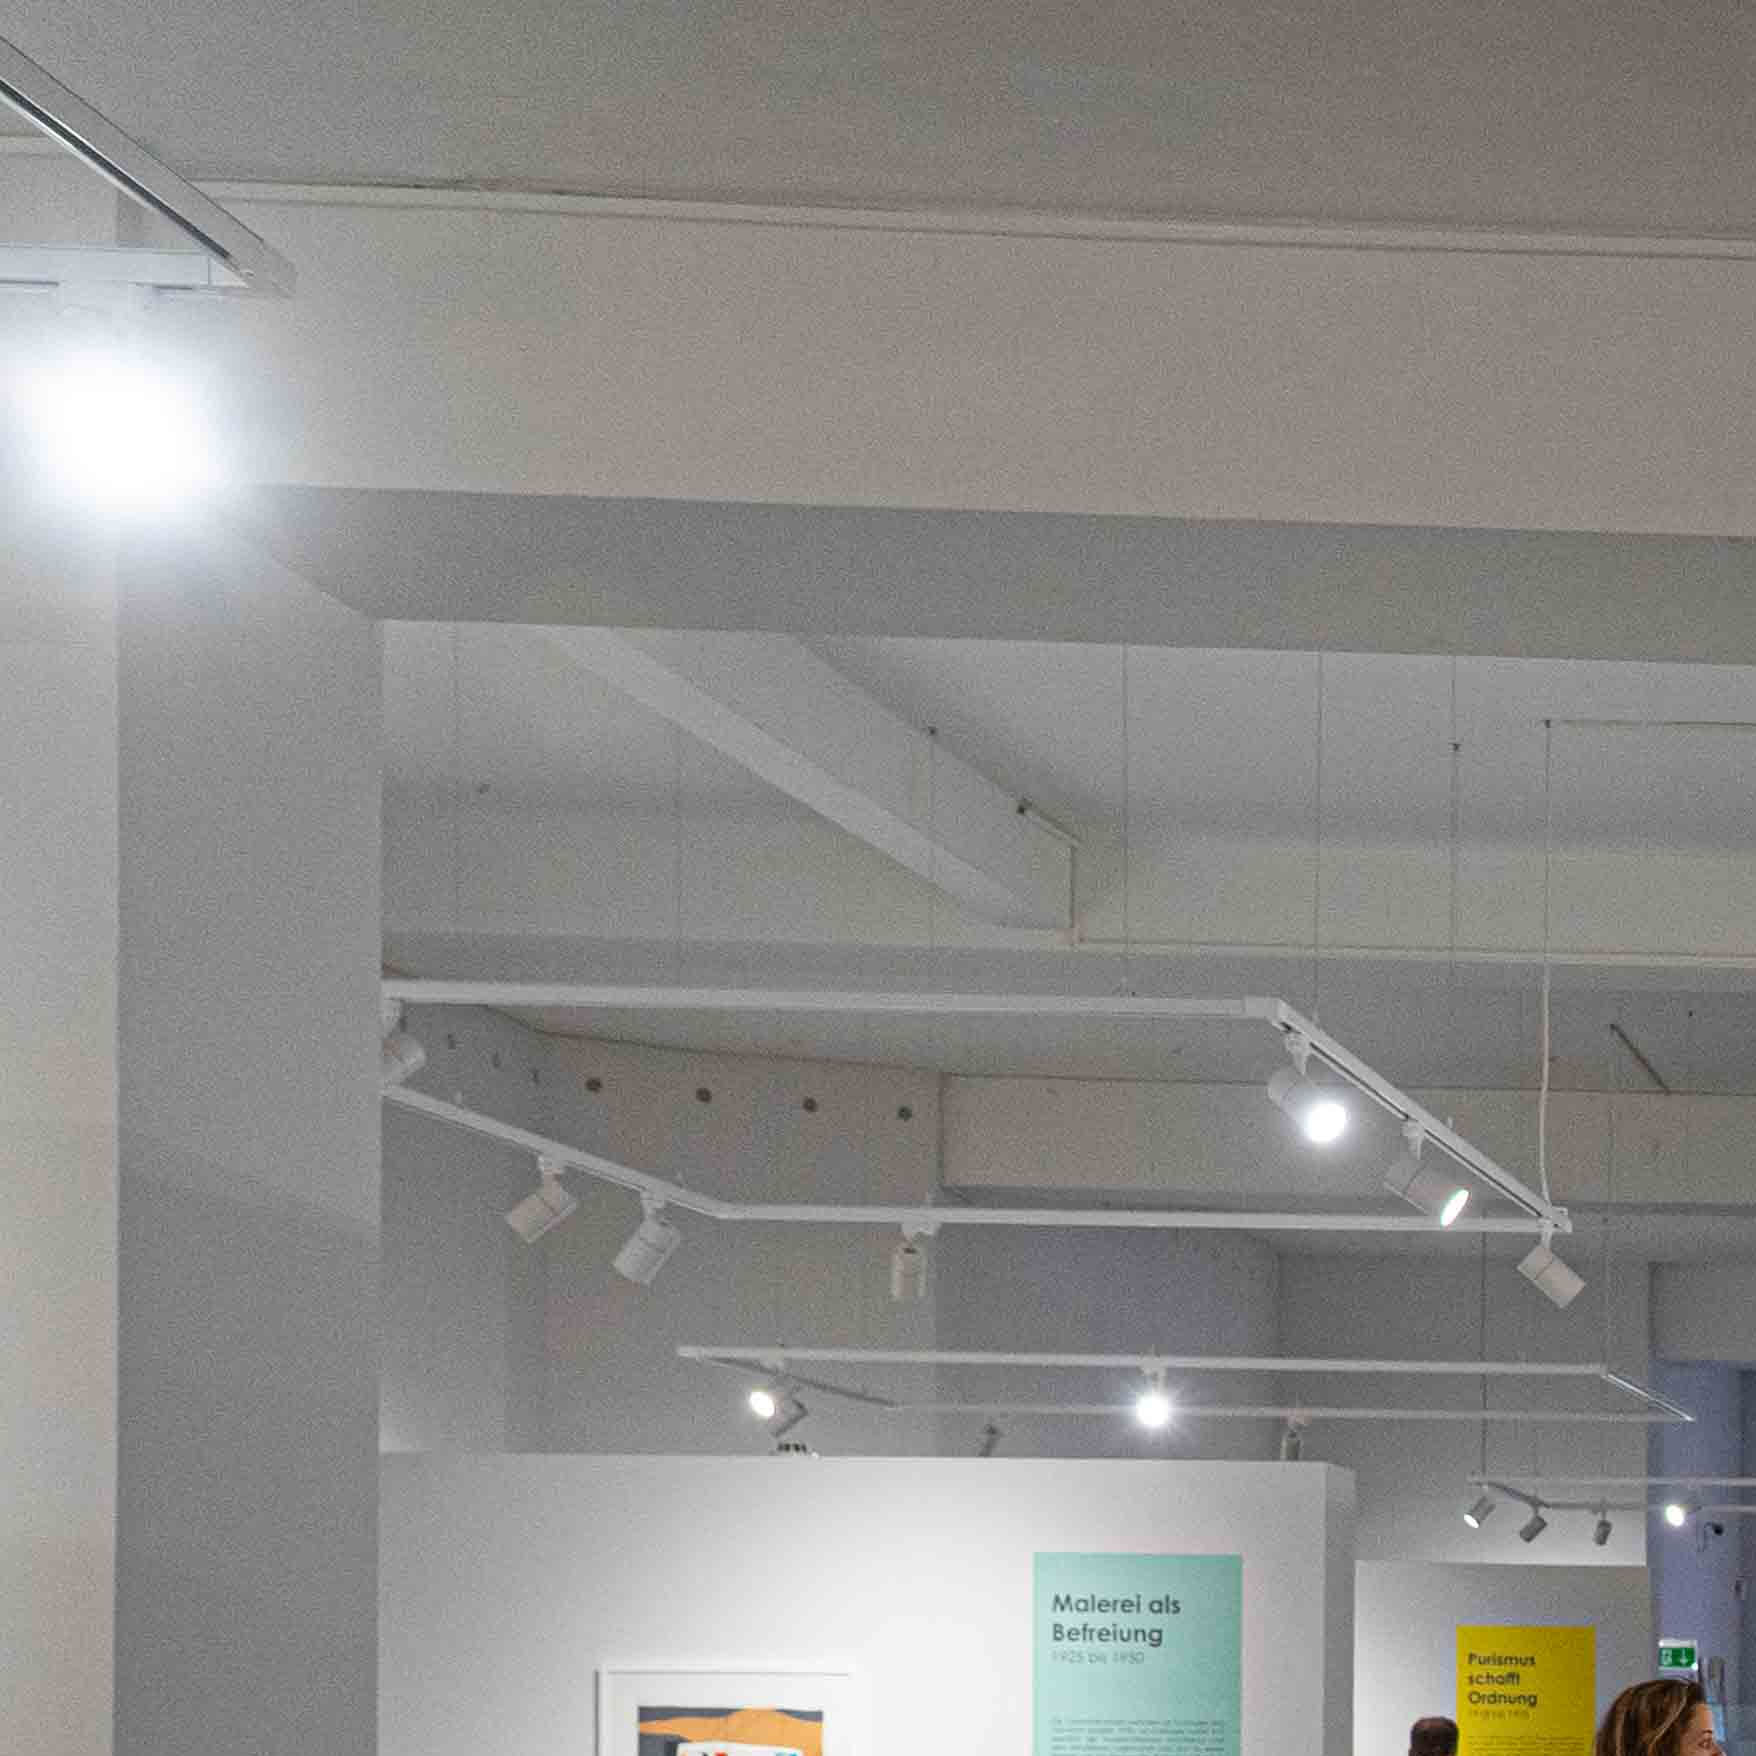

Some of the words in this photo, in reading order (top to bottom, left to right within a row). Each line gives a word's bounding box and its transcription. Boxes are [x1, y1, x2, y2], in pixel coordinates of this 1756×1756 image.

[1052, 1594, 1141, 1613] Malerei
[1148, 1594, 1181, 1614] als
[1053, 1623, 1163, 1648] Befreiung
[1468, 1652, 1536, 1666] Purismus
[1468, 1691, 1537, 1708] Ordnung
